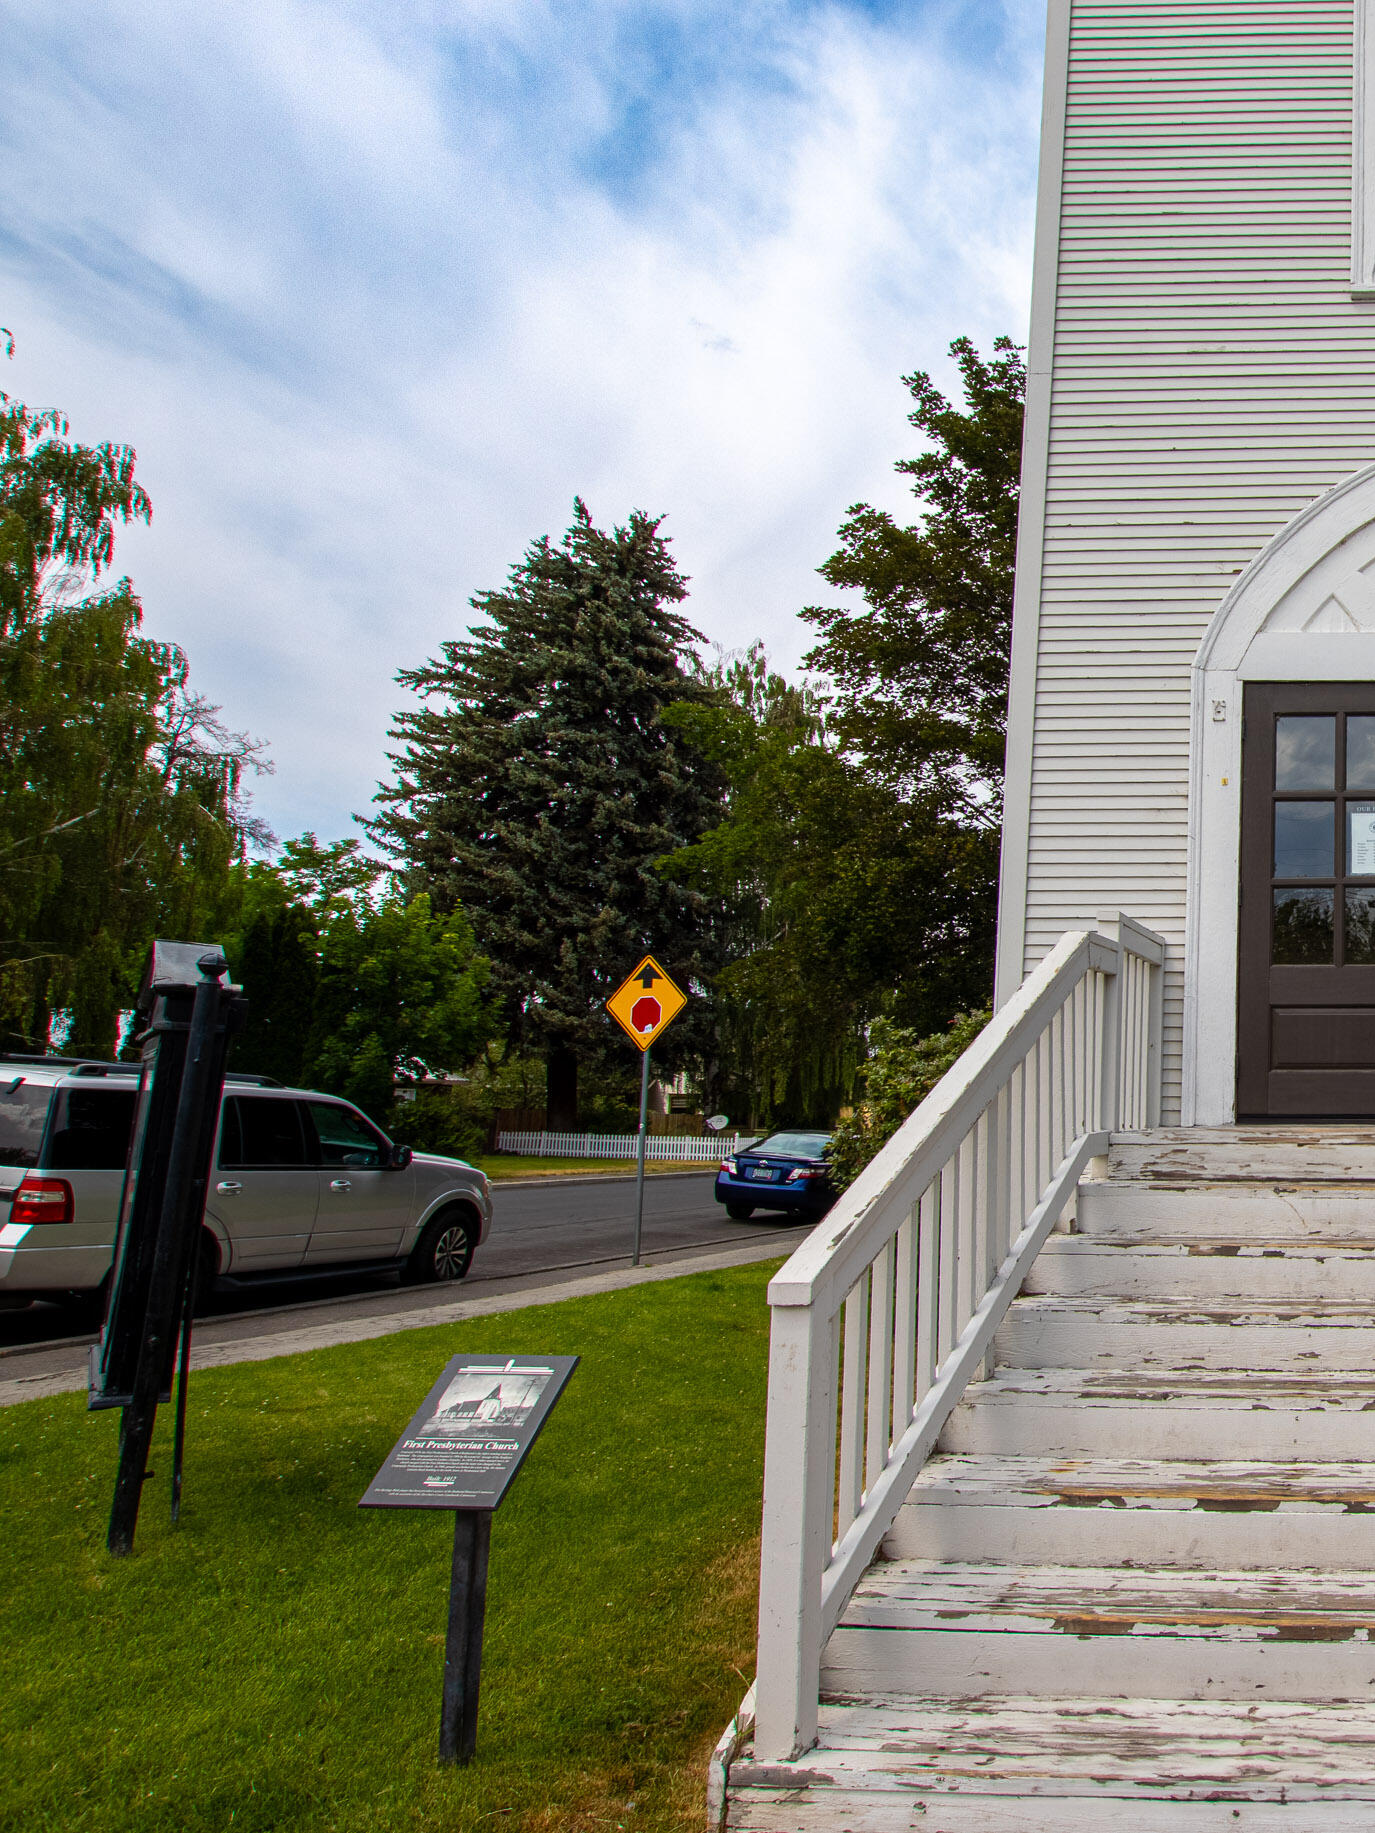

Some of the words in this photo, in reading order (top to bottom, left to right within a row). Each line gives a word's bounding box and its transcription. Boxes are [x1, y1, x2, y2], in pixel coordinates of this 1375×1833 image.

[402, 1440, 426, 1449] First
[426, 1440, 484, 1451] Presbyterian
[484, 1441, 520, 1450] Church
